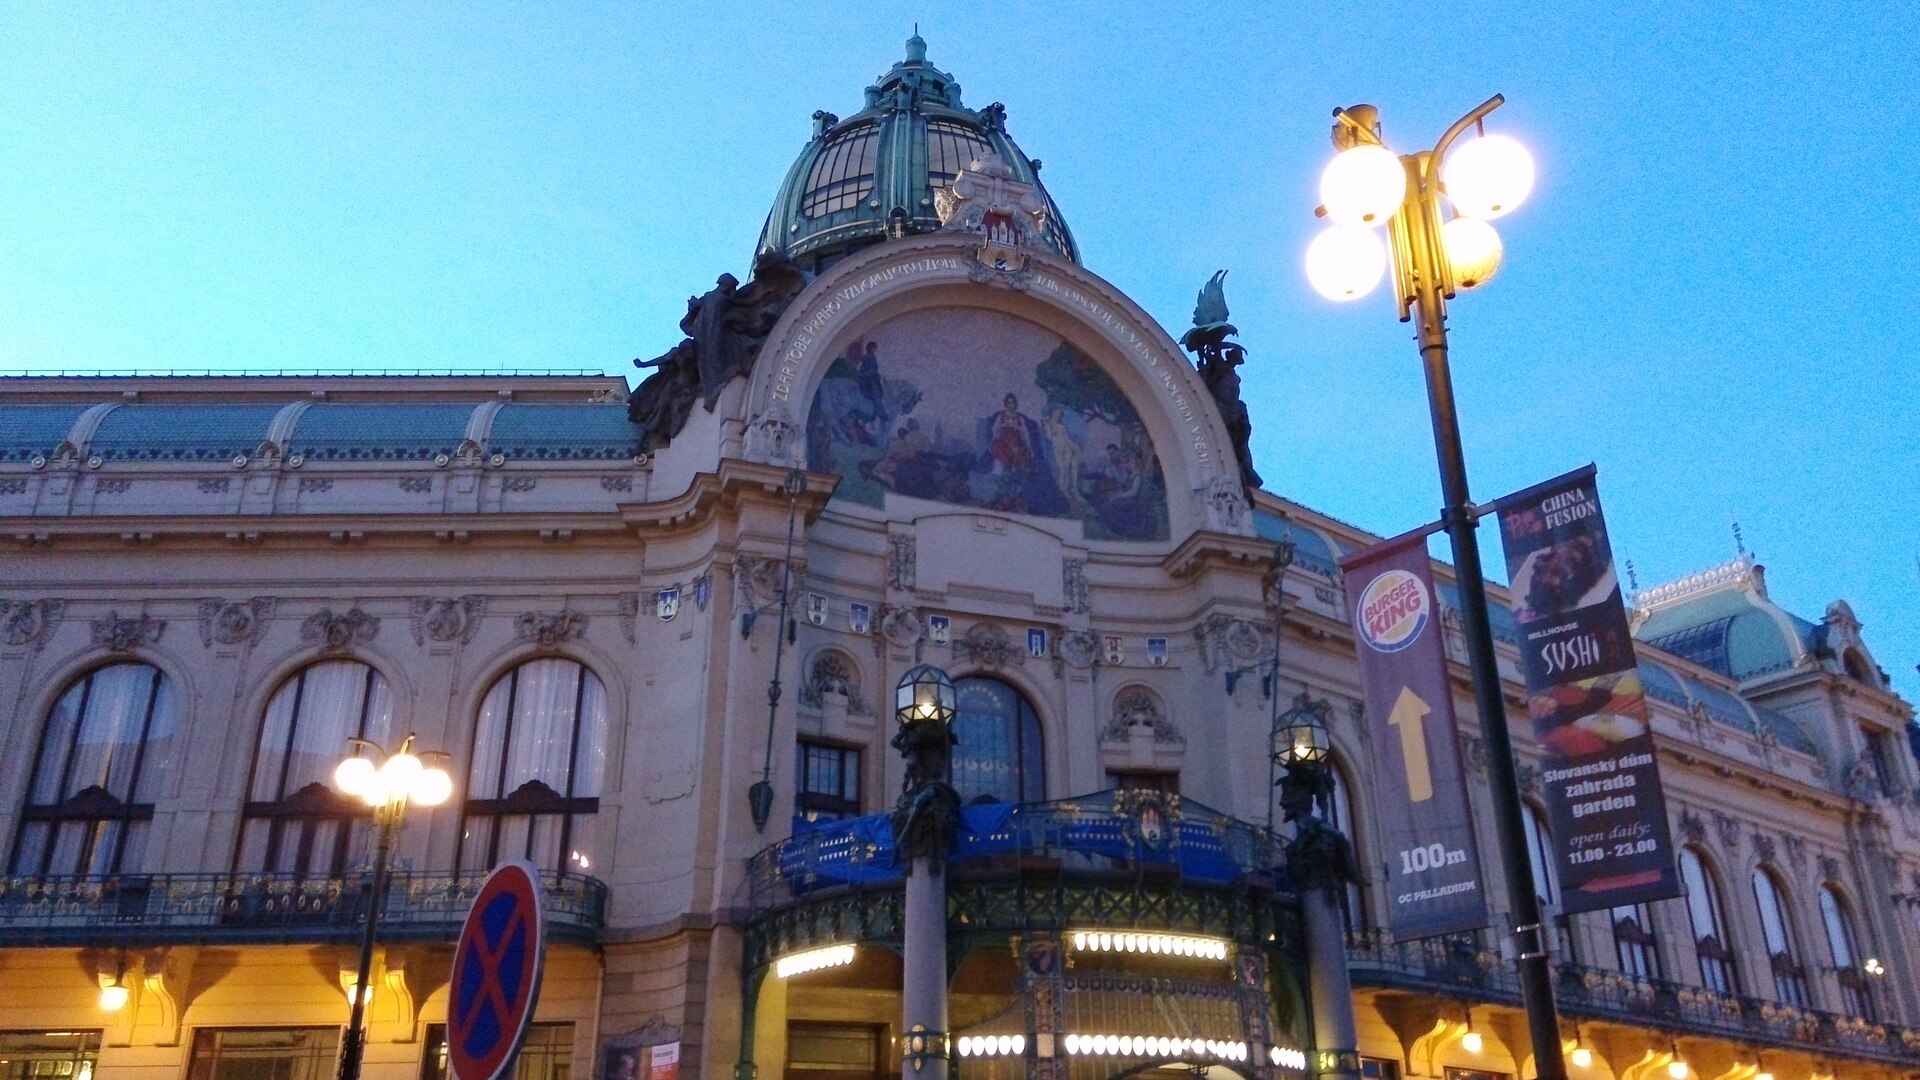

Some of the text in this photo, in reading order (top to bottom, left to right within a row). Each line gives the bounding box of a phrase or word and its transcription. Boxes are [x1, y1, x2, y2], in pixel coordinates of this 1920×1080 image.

[773, 367, 795, 402] ZDAR
[1541, 487, 1586, 514] CHINA
[1545, 499, 1597, 530] FUSION
[1364, 578, 1416, 624] BURGER
[1370, 590, 1421, 641] KING
[1527, 622, 1579, 641] MILLHOUSE
[1543, 753, 1653, 783] Slovanský dům
[1565, 774, 1637, 798] zahrada
[1572, 795, 1637, 818] garden
[1569, 821, 1651, 849] open daily:
[1568, 847, 1604, 865] 11.00
[1614, 838, 1657, 857] 23.00
[1398, 881, 1477, 904] OC PALLADIUM
